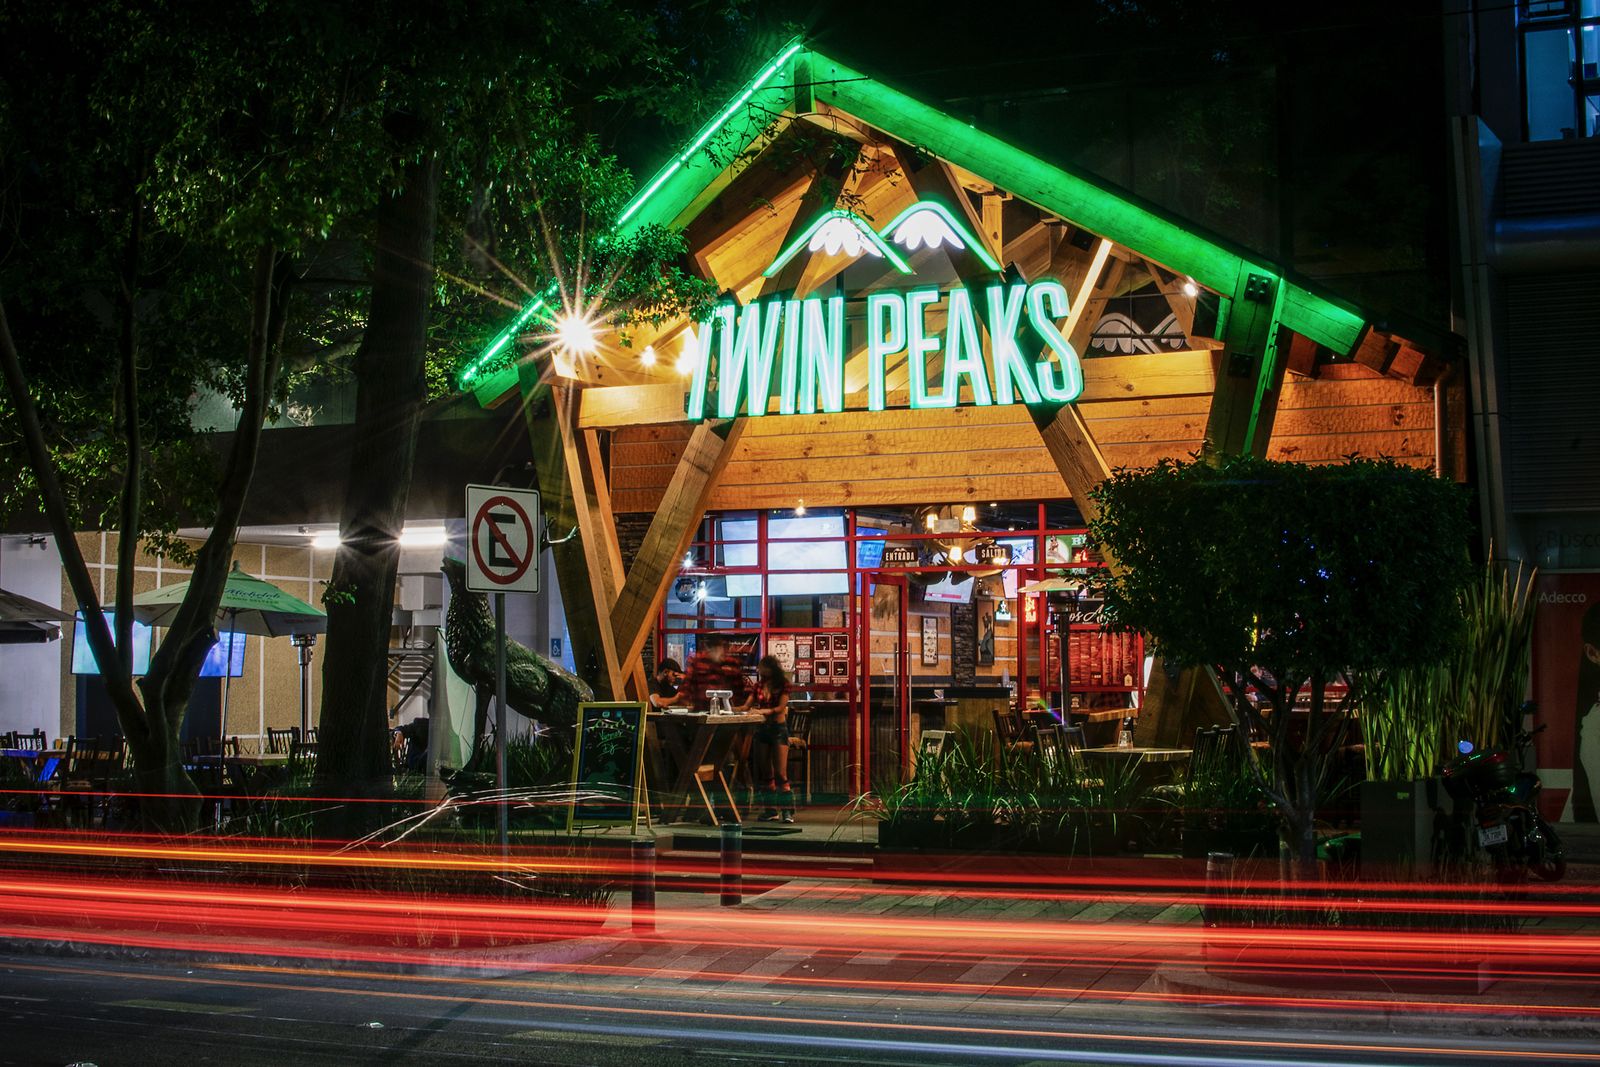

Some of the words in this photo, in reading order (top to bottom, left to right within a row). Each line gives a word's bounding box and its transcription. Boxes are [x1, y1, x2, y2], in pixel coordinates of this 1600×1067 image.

[867, 282, 1084, 412] PEAKS
[885, 551, 915, 562] ENTRADA
[1539, 592, 1587, 604] Adecco
